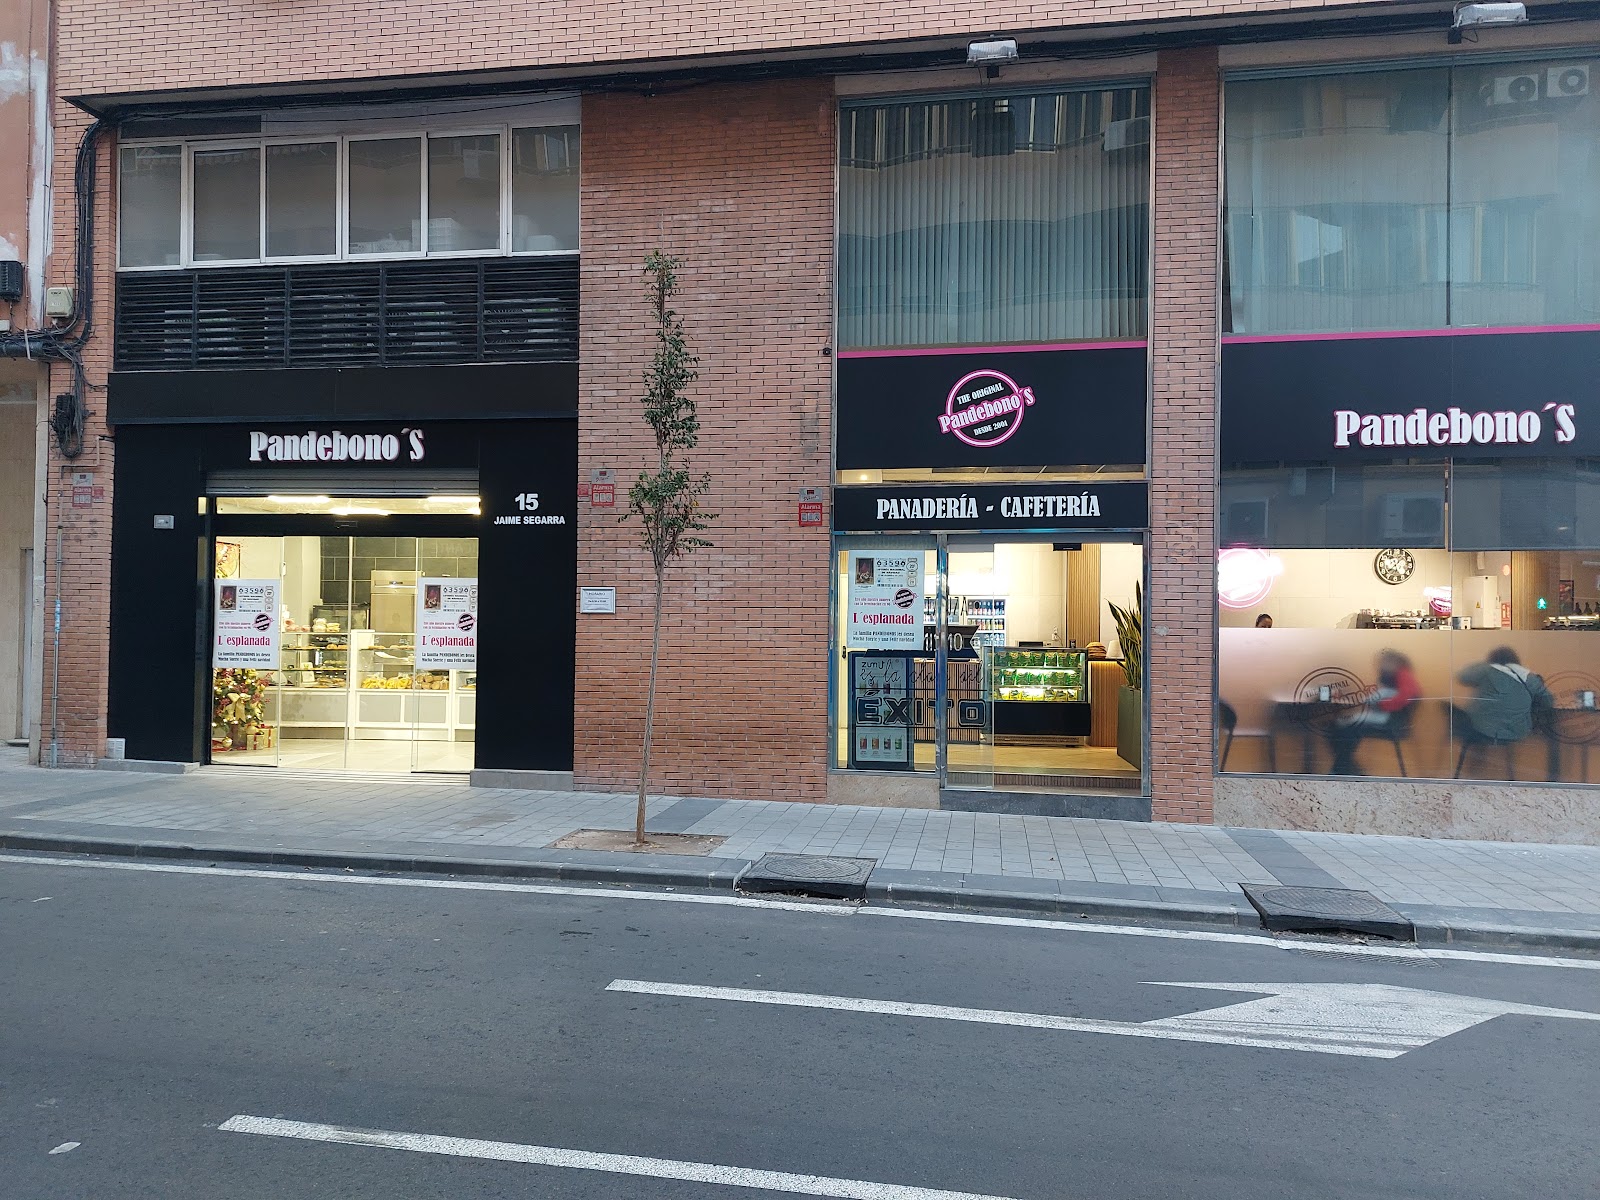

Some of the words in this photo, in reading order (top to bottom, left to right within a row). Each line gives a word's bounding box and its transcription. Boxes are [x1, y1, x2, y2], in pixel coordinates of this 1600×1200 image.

[956, 394, 971, 404] THE
[972, 382, 1004, 400] ORIGINAL
[973, 424, 992, 436] DESDE
[993, 420, 1008, 430] 2001
[515, 493, 539, 510] 15
[876, 493, 978, 520] PANADERÍA
[1000, 492, 1100, 518] CAFETERÍA
[494, 516, 521, 525] JAIME
[523, 516, 565, 524] SEGARRA
